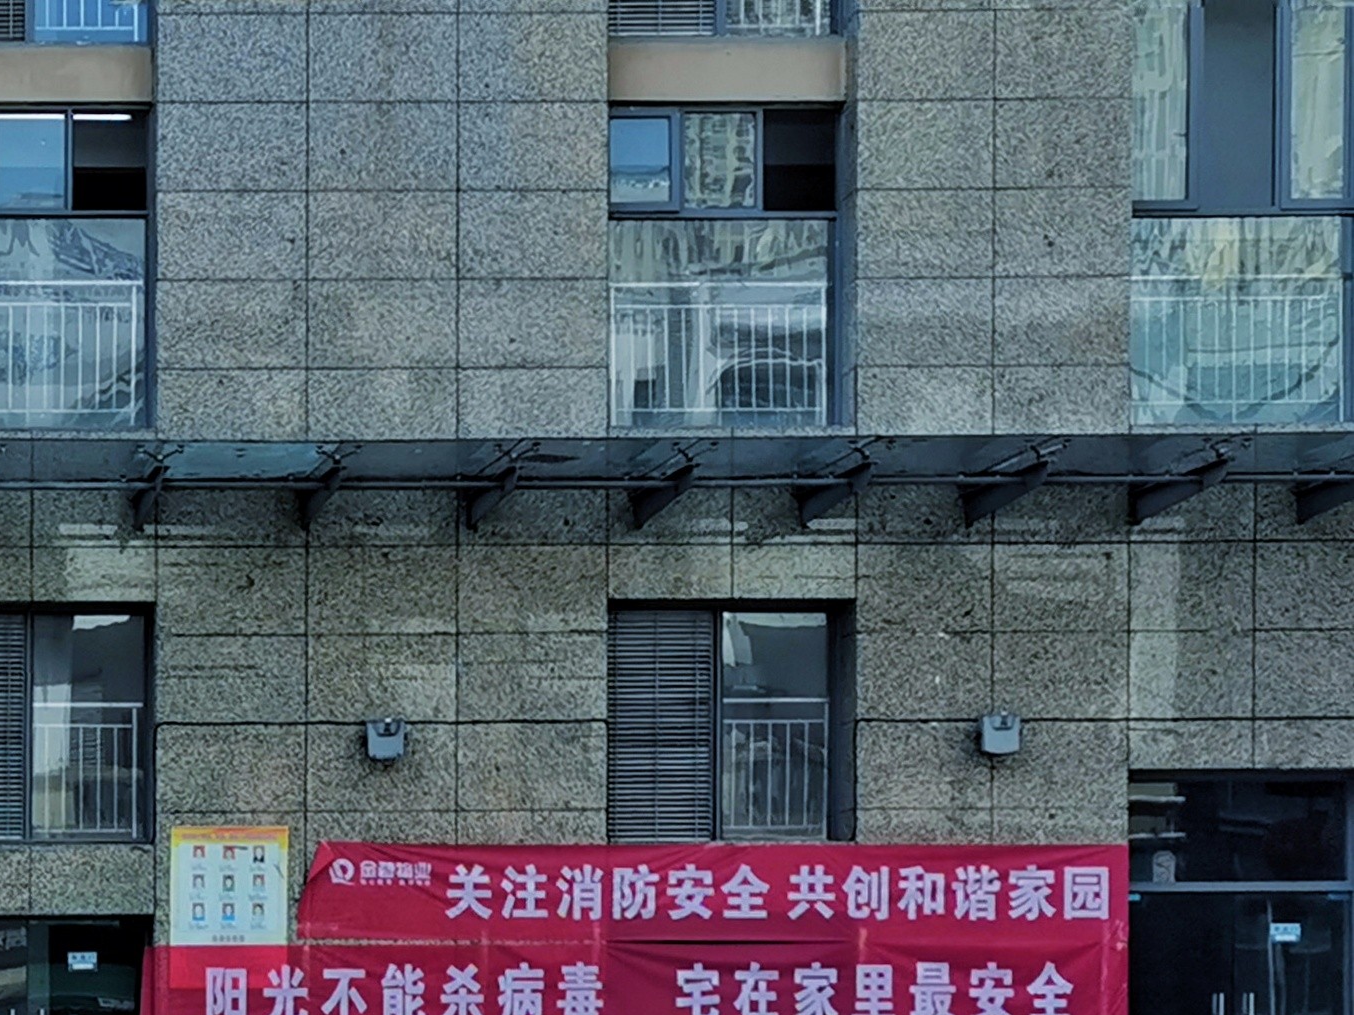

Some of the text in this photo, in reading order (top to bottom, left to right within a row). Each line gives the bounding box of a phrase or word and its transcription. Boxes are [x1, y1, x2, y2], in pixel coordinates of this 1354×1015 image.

[445, 863, 1110, 921] 关注消防安全 共创和谐家园
